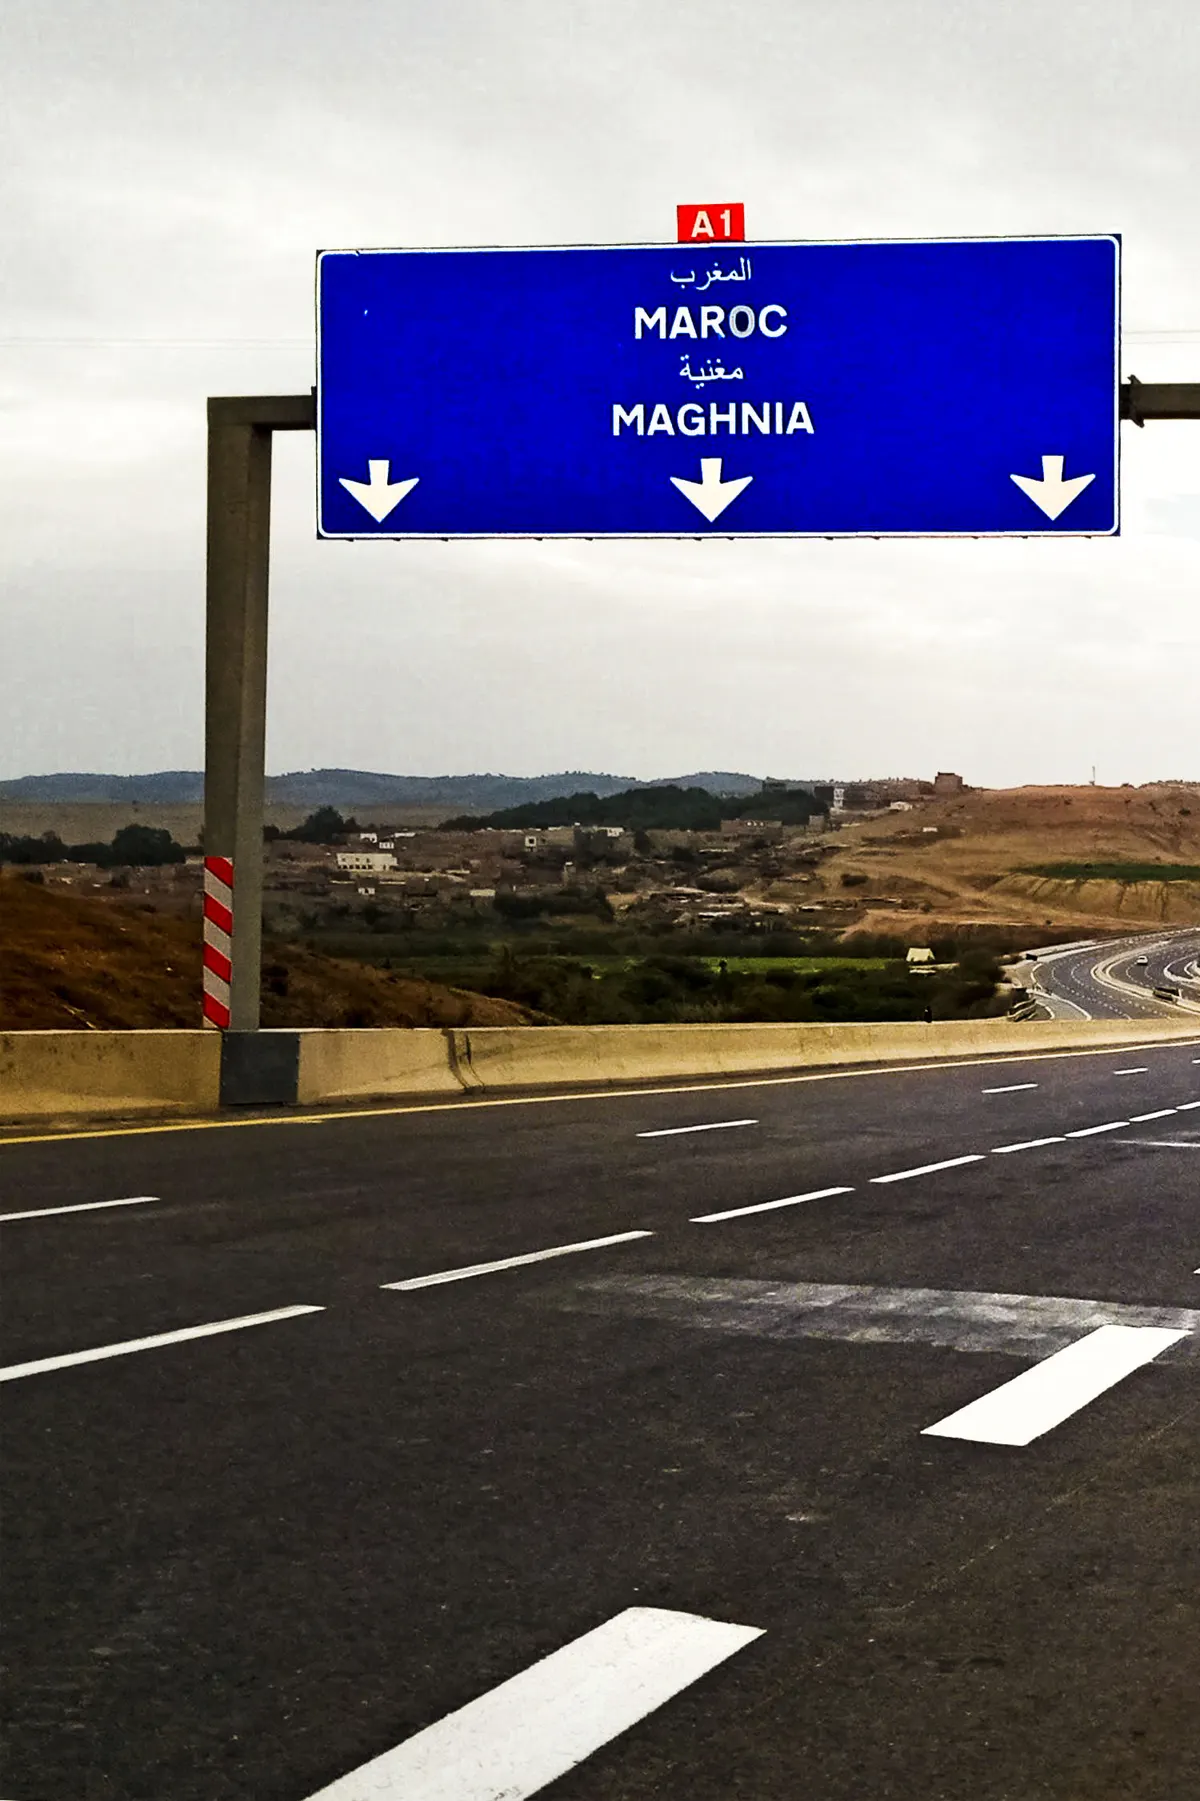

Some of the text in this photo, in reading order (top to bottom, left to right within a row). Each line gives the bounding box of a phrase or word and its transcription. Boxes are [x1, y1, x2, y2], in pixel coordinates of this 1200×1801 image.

[691, 209, 731, 238] A1
[670, 257, 752, 290] المغرب
[634, 304, 788, 339] MAROC
[679, 354, 744, 389] مغنية
[612, 401, 814, 437] MAGHNIA
